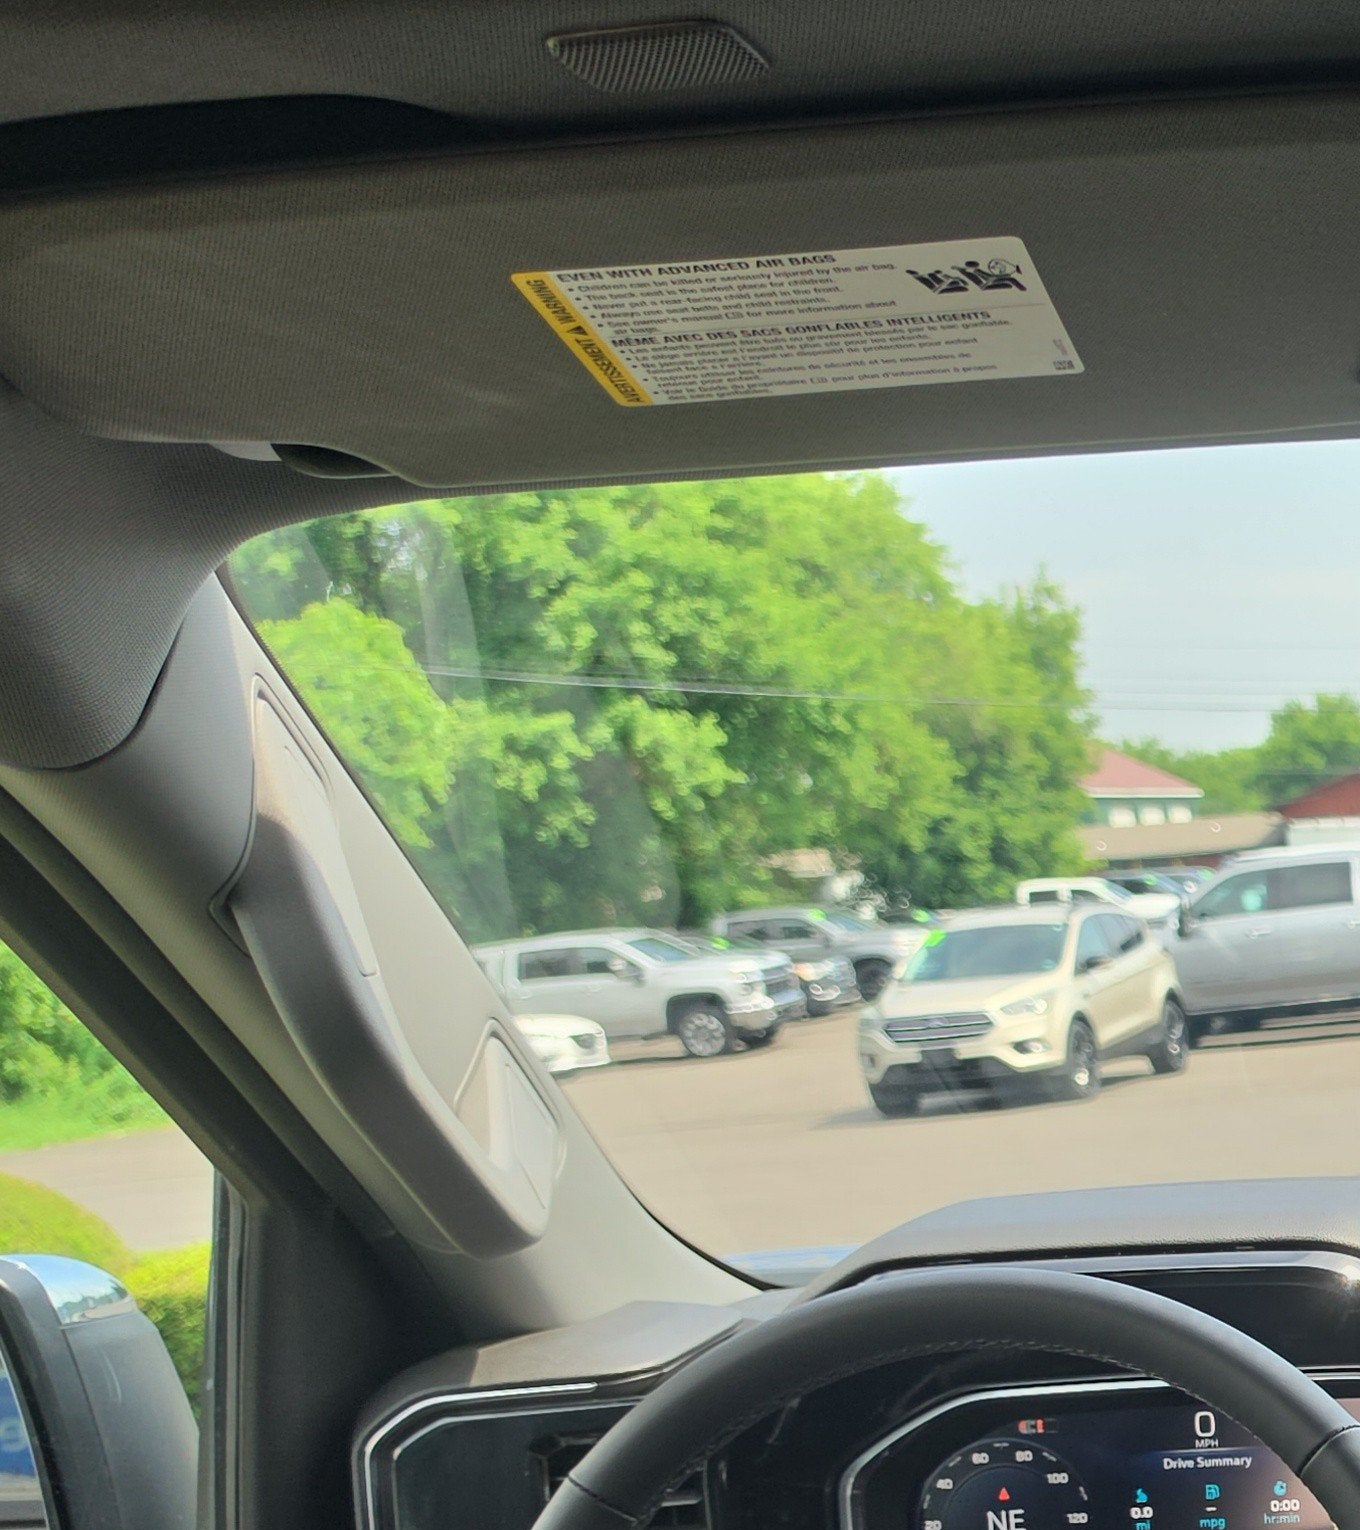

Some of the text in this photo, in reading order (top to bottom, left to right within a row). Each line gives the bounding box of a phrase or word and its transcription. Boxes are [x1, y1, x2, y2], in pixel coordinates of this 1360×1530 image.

[556, 254, 837, 283] EVEN WITH ADVANCED AIR BAGS
[629, 281, 650, 290] can
[670, 276, 703, 286] killed
[773, 268, 814, 280] injured
[815, 266, 831, 276] by
[832, 265, 852, 274] the
[854, 263, 869, 273] air
[609, 290, 636, 300] back
[639, 289, 664, 298] seat
[678, 286, 698, 295] the
[736, 280, 768, 292] place
[769, 279, 785, 288] for
[526, 279, 576, 326] WARNING
[663, 332, 704, 344] AVEC
[706, 330, 738, 341] DES
[740, 326, 782, 338] SACS
[785, 320, 883, 334] GONFLABLES
[886, 310, 992, 327] INTELLIGENTS
[1194, 1411, 1216, 1437] 0
[1195, 1438, 1219, 1448] MPH
[1163, 1455, 1253, 1470] Drive Summary
[1129, 1506, 1154, 1520] 0.0
[1270, 1499, 1301, 1512] 0:00
[1135, 1520, 1151, 1530] mi
[1199, 1517, 1226, 1530] mpg
